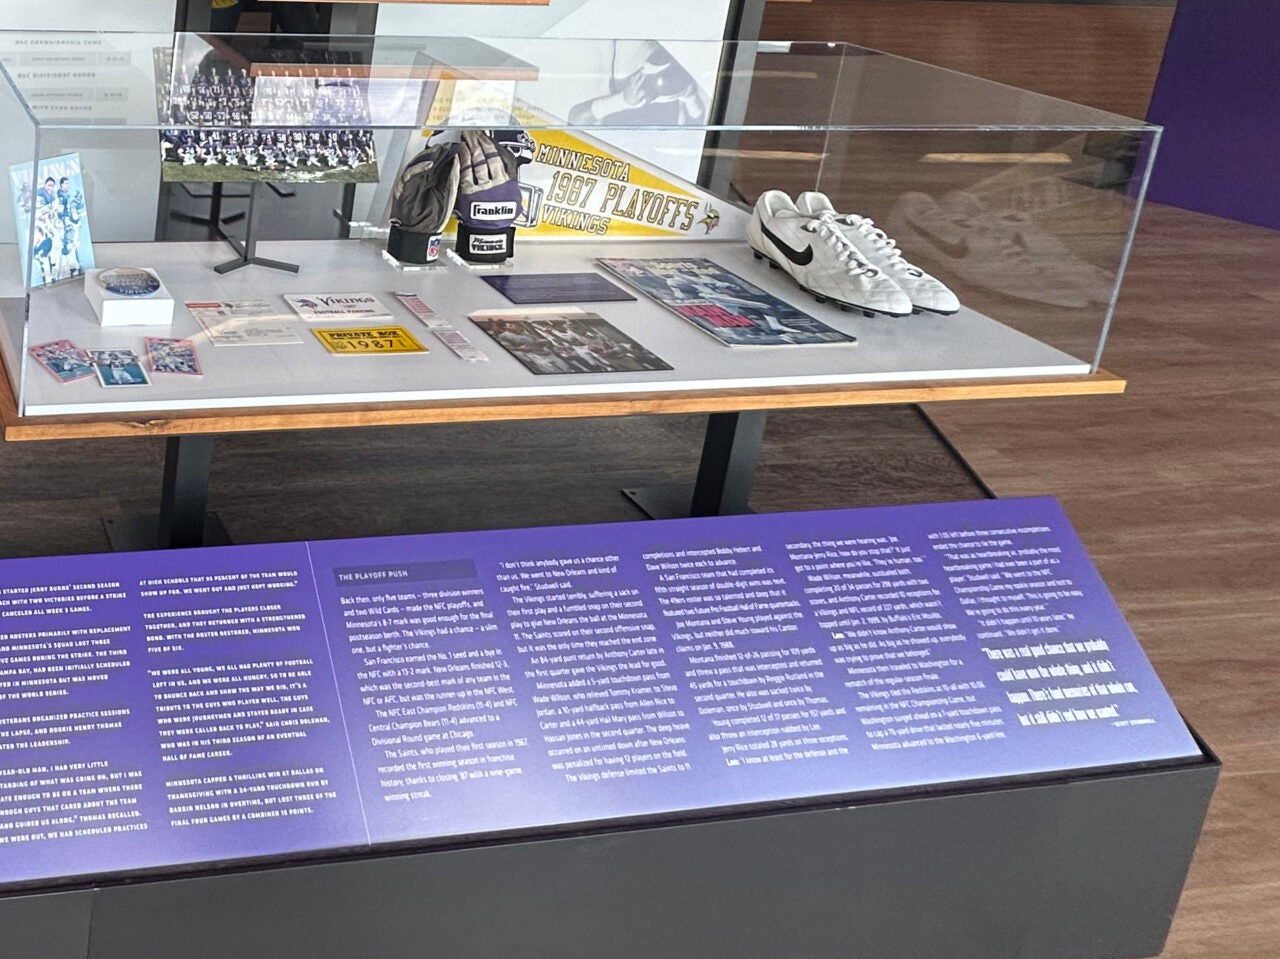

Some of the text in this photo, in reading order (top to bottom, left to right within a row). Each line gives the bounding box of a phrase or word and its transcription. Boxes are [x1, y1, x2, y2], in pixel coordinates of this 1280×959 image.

[535, 143, 631, 183] MINNESOTA
[546, 170, 699, 231] 1987 PLAYOFFS
[473, 204, 513, 217] Franklin
[539, 205, 612, 236] VIKINGS
[347, 339, 393, 349] 1987
[354, 571, 387, 580] PLAYOFF
[388, 570, 408, 578] PUSH
[2, 587, 28, 595] STARTED
[72, 583, 95, 591] SECOND
[37, 630, 70, 638] PRIMARILY
[88, 626, 131, 634] REPLACEMENT
[32, 714, 67, 722] ORGANIZED
[69, 711, 98, 719] PRACTICE
[100, 709, 130, 717] SESSIONS
[29, 739, 71, 748] LEADERSHIP.
[206, 750, 232, 758] CAREER.
[165, 778, 201, 787] MINNESOTA
[202, 776, 227, 784] CAPPED
[234, 773, 266, 781] THRILLING
[290, 768, 313, 776] DALLAS
